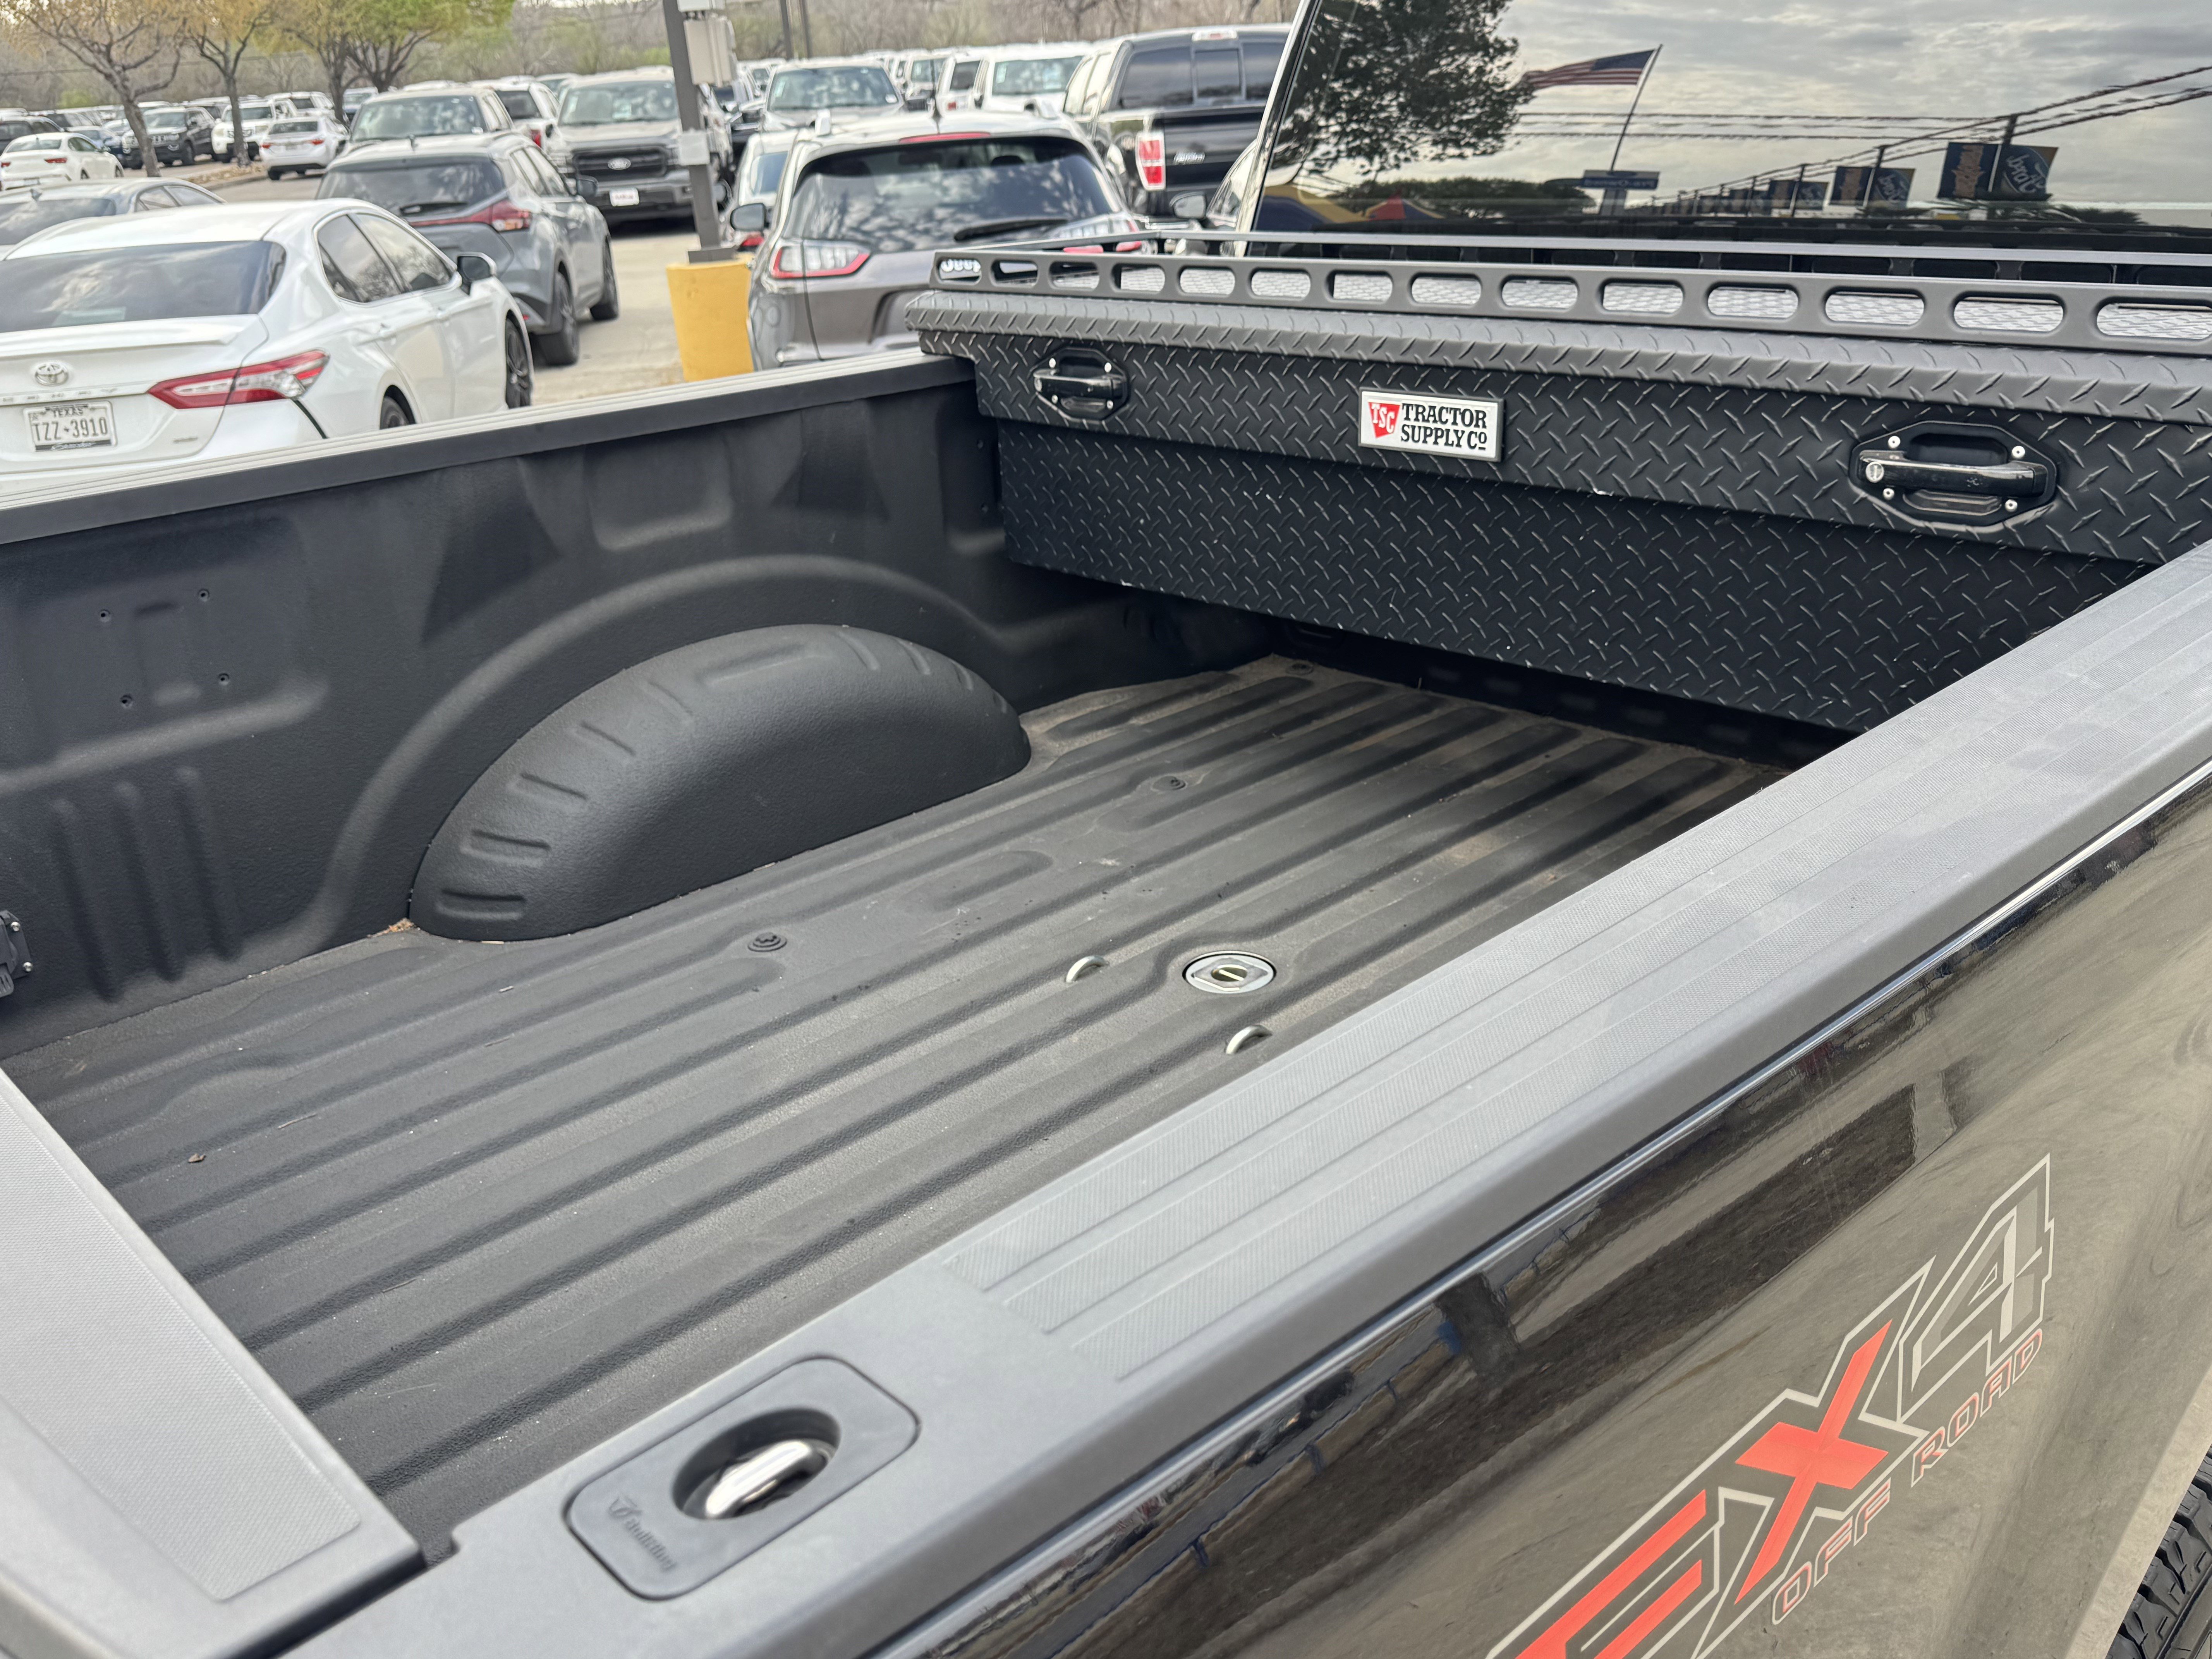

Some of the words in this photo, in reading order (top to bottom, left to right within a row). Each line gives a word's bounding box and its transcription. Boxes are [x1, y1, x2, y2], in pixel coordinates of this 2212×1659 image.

[52, 407, 84, 418] TEXAS
[1371, 403, 1395, 433] TSC
[1402, 403, 1487, 429] TRACTOR
[1401, 424, 1465, 448] SUPPLY
[1772, 1477, 1891, 1625] OFF
[1911, 1328, 2042, 1488] ROAD
